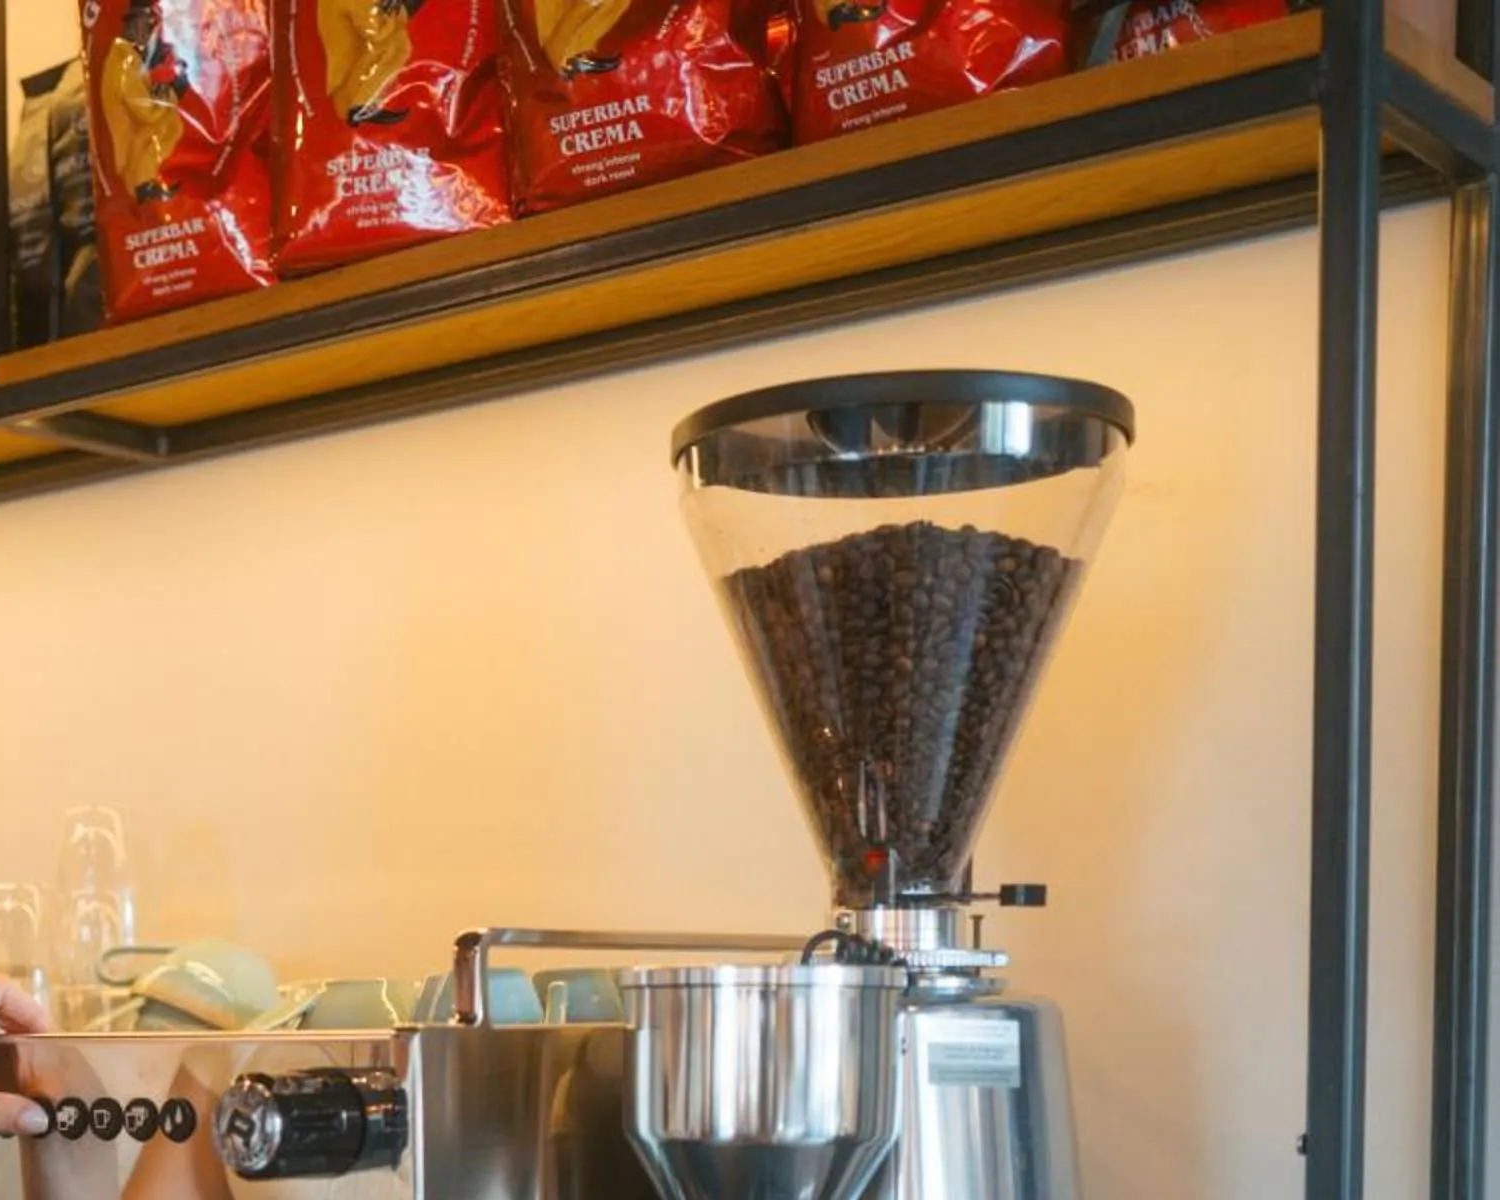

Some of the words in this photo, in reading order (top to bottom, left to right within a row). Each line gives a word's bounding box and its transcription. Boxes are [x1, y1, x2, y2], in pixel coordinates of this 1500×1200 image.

[816, 41, 915, 88] SUPERBAR
[828, 68, 909, 110] CREMA
[550, 95, 651, 134] SUPERBAR
[560, 120, 644, 156] CREMA
[125, 218, 206, 250] SUPERBAR
[133, 239, 200, 269] CREMA
